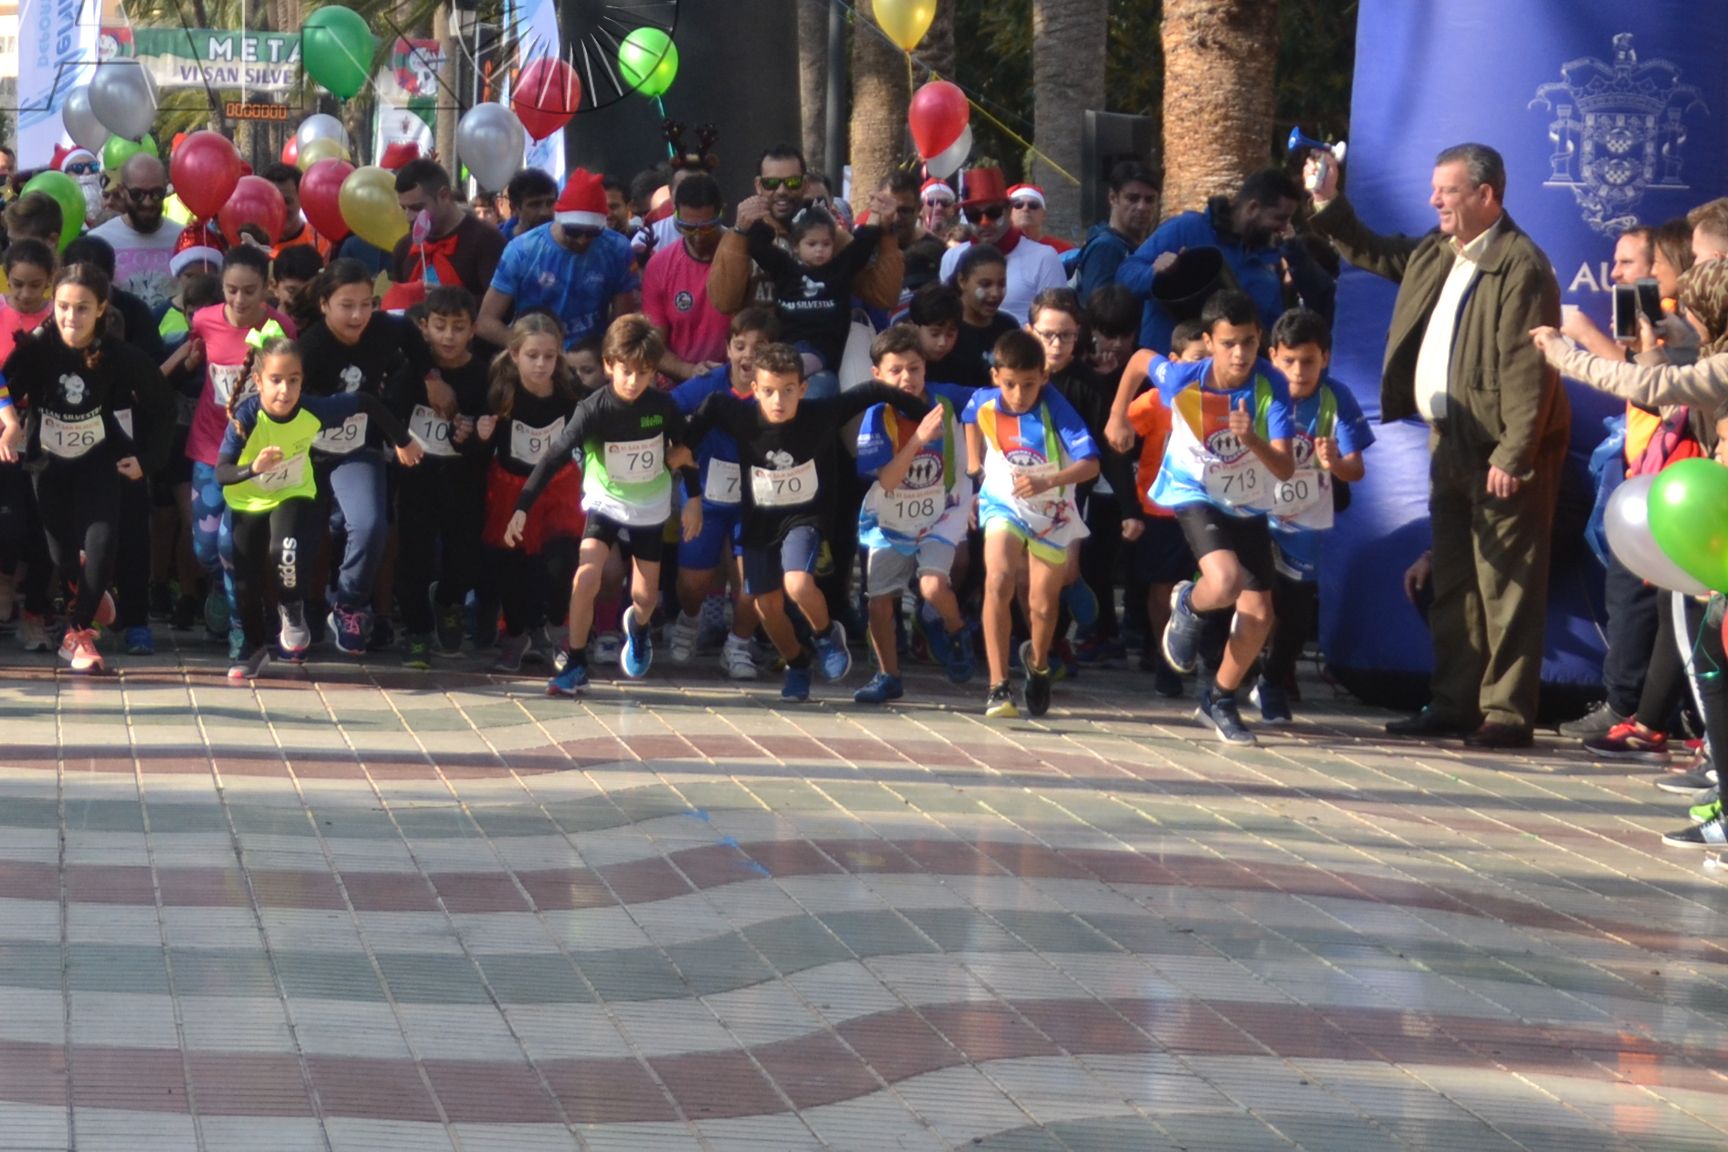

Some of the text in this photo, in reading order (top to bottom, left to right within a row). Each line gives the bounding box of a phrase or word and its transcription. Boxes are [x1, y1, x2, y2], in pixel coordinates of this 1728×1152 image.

[203, 66, 239, 83] SAN
[244, 68, 294, 85] SILVE
[54, 430, 96, 448] 126
[528, 434, 553, 454] 91
[627, 450, 654, 471] 79
[264, 467, 289, 484] 74
[1221, 467, 1257, 495] 713
[772, 476, 802, 495] 70
[895, 497, 935, 519] 108
